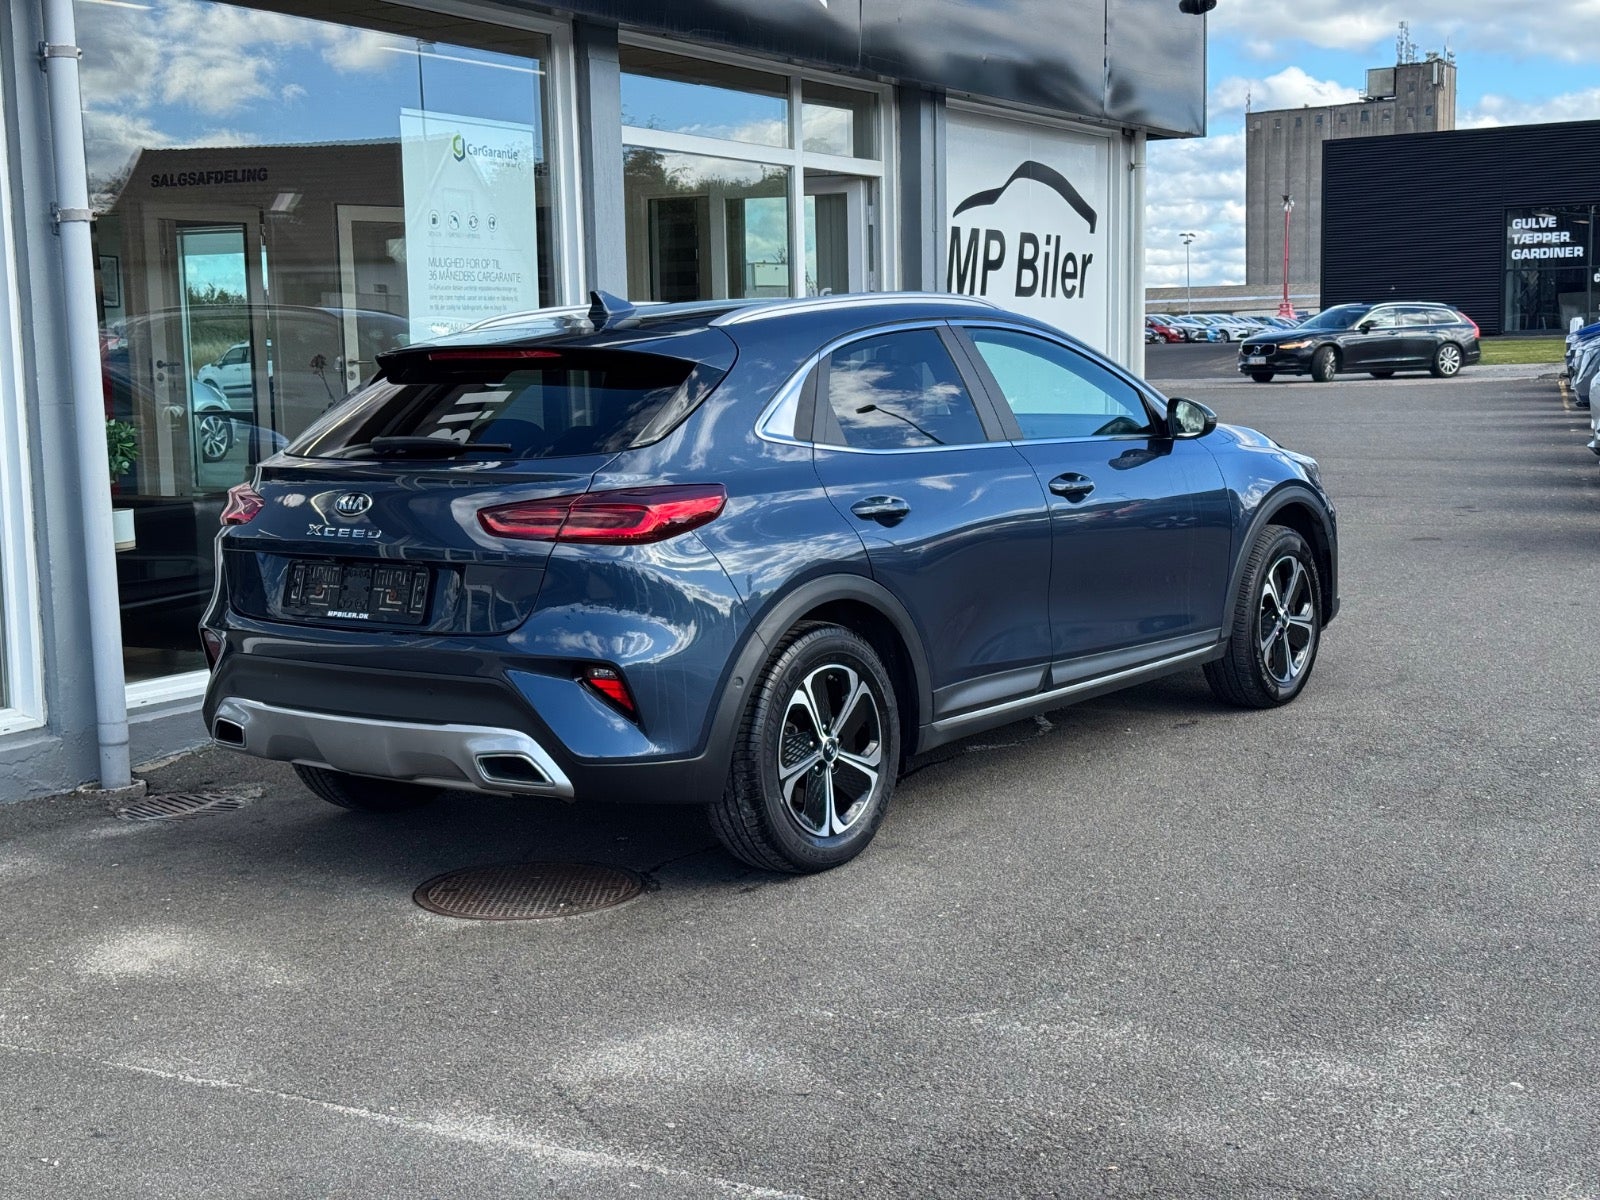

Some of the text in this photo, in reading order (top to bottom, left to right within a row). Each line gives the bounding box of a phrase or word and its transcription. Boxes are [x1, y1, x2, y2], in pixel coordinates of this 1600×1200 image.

[467, 144, 518, 160] CarGarantie
[151, 168, 268, 187] SALGSAFDELING
[1512, 217, 1557, 229] GULVE
[1512, 232, 1570, 244] TÆPPER
[1511, 247, 1584, 260] GARDINER
[947, 226, 1093, 299] MP Biler
[428, 271, 437, 280] 36
[338, 496, 363, 510] KIA
[307, 524, 382, 538] XCEED
[327, 610, 369, 619] MPBILER.DK
